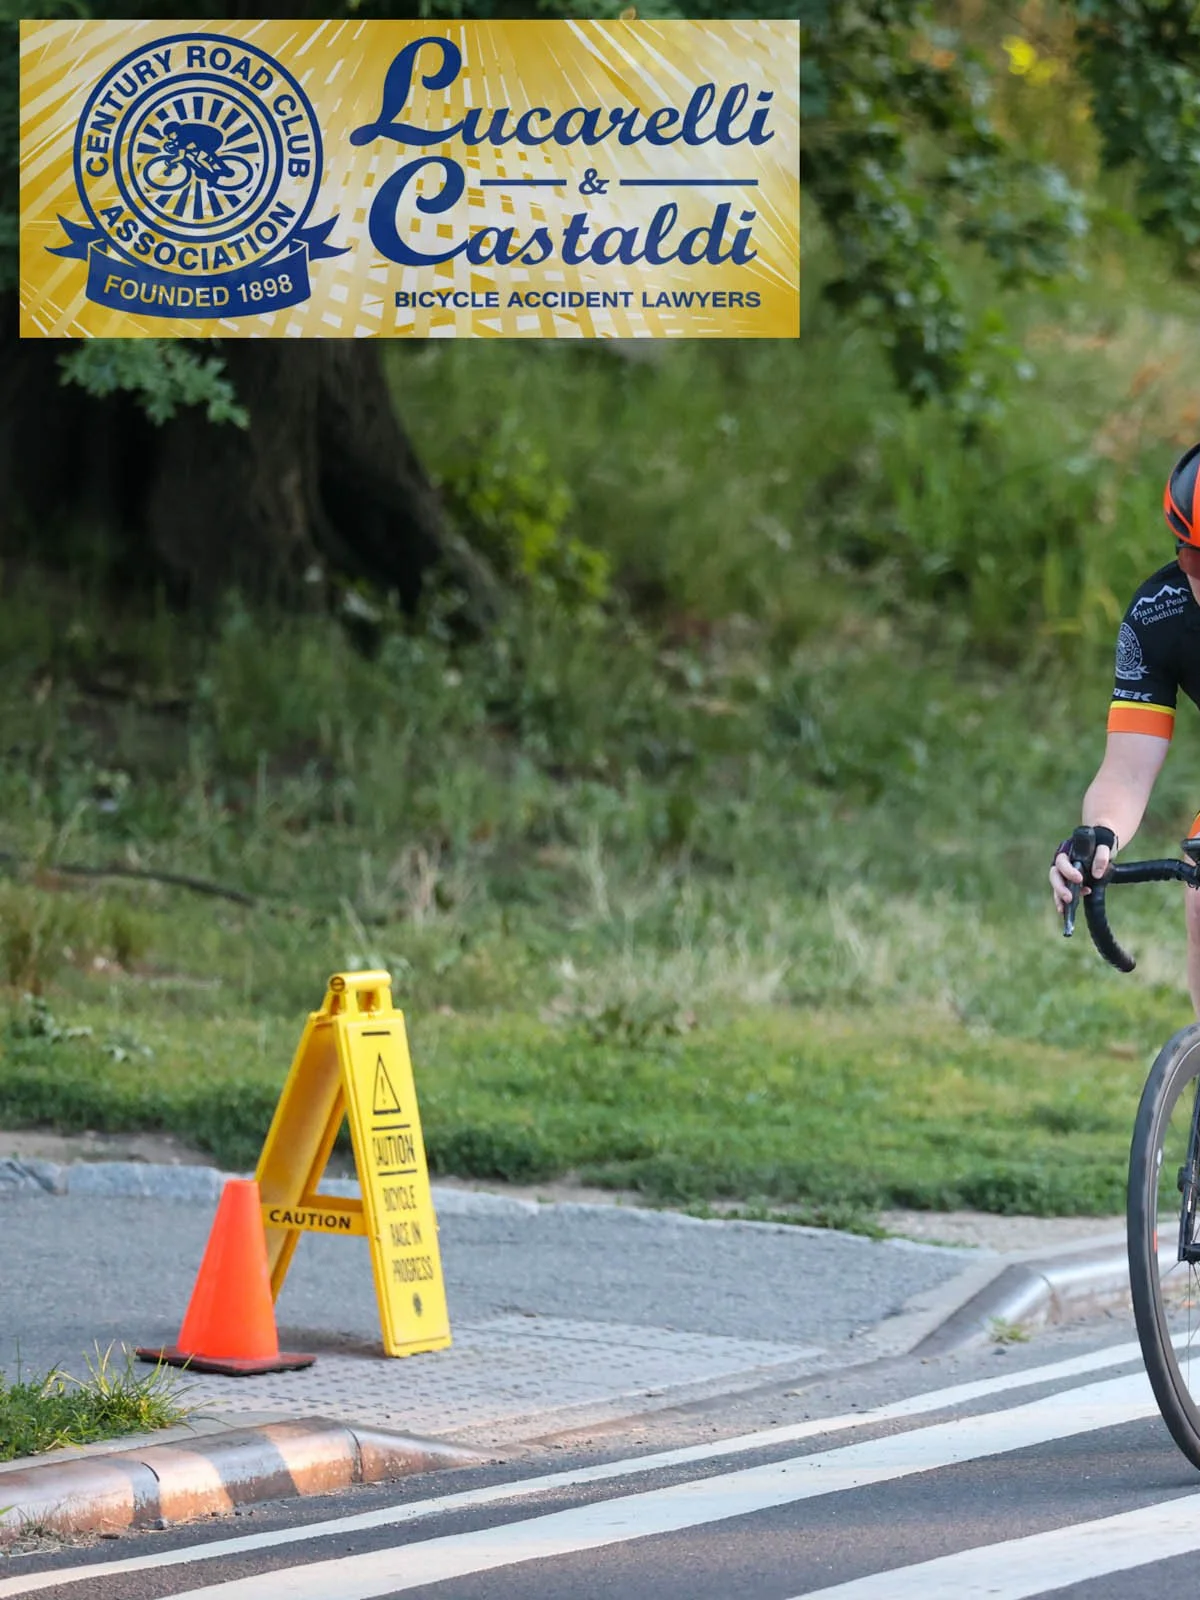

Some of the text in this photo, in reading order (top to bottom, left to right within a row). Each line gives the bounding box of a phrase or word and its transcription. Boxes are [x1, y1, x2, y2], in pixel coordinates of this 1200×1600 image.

[1133, 607, 1153, 621] Plan
[1154, 603, 1165, 612] to
[1141, 605, 1185, 626] Coaching
[1113, 688, 1153, 702] REK
[372, 1133, 417, 1167] CAUTION
[269, 1209, 351, 1230] CAUTION
